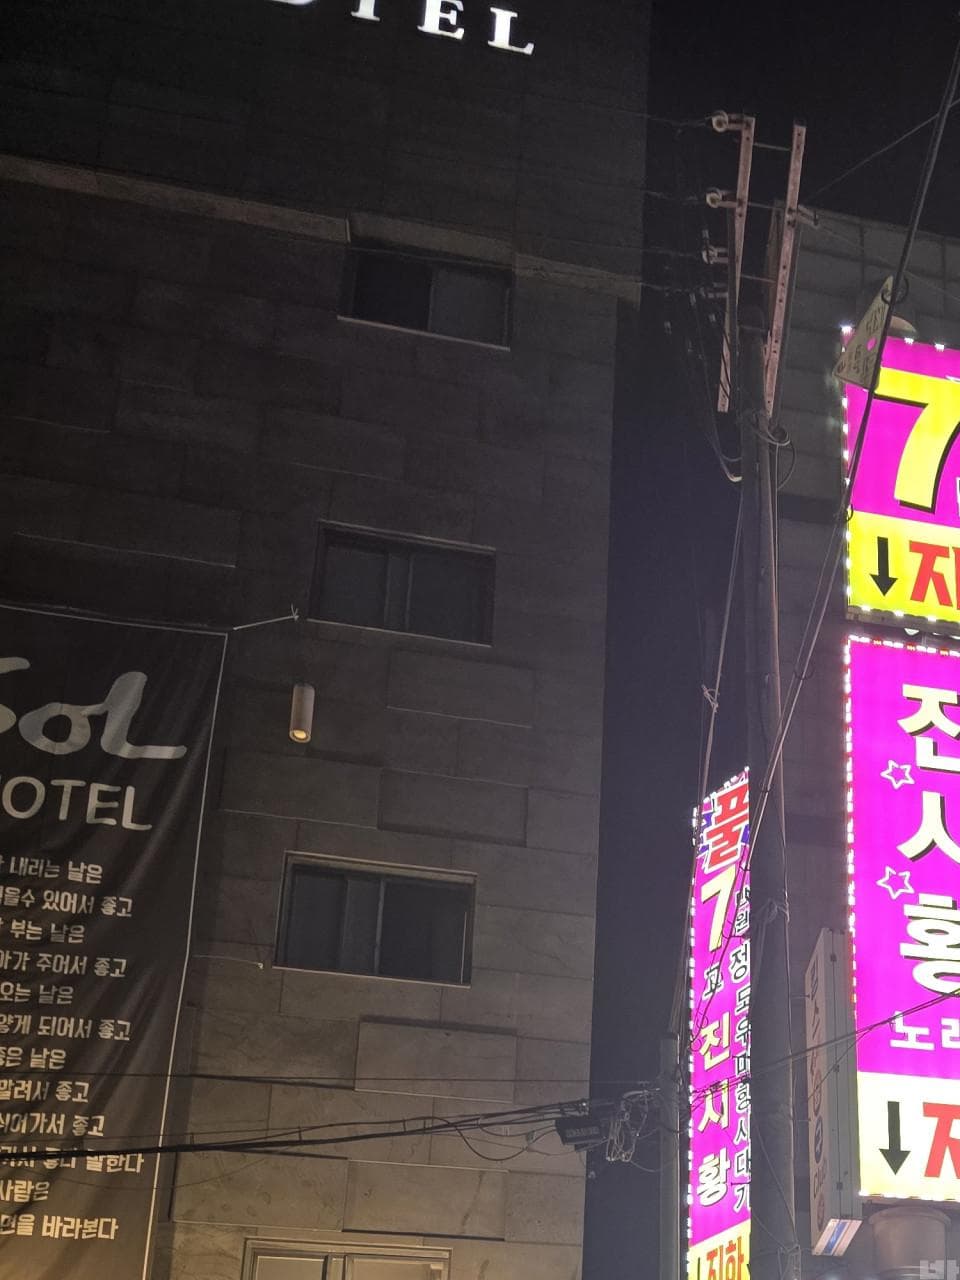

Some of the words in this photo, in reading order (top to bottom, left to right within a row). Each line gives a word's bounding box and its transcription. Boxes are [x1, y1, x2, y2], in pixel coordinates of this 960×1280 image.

[0, 776, 152, 831] OTEL
[9, 856, 60, 878] 내리는
[68, 861, 103, 885] 날은
[42, 889, 95, 914] 있어서
[100, 896, 133, 918] 좋고
[701, 865, 735, 952] 7
[10, 919, 43, 941] 부는
[50, 923, 85, 944] 날은
[36, 953, 87, 975] 주어서
[94, 957, 127, 978] 좋고
[0, 981, 31, 1003] 오는
[38, 984, 74, 1005] 날은
[37, 1016, 92, 1038] 되어서
[98, 1019, 131, 1041] 좋고
[30, 1048, 66, 1070] 날은
[55, 1080, 89, 1103] 좋고
[72, 1115, 105, 1137] 좋고
[42, 1214, 119, 1240] 바라본다
